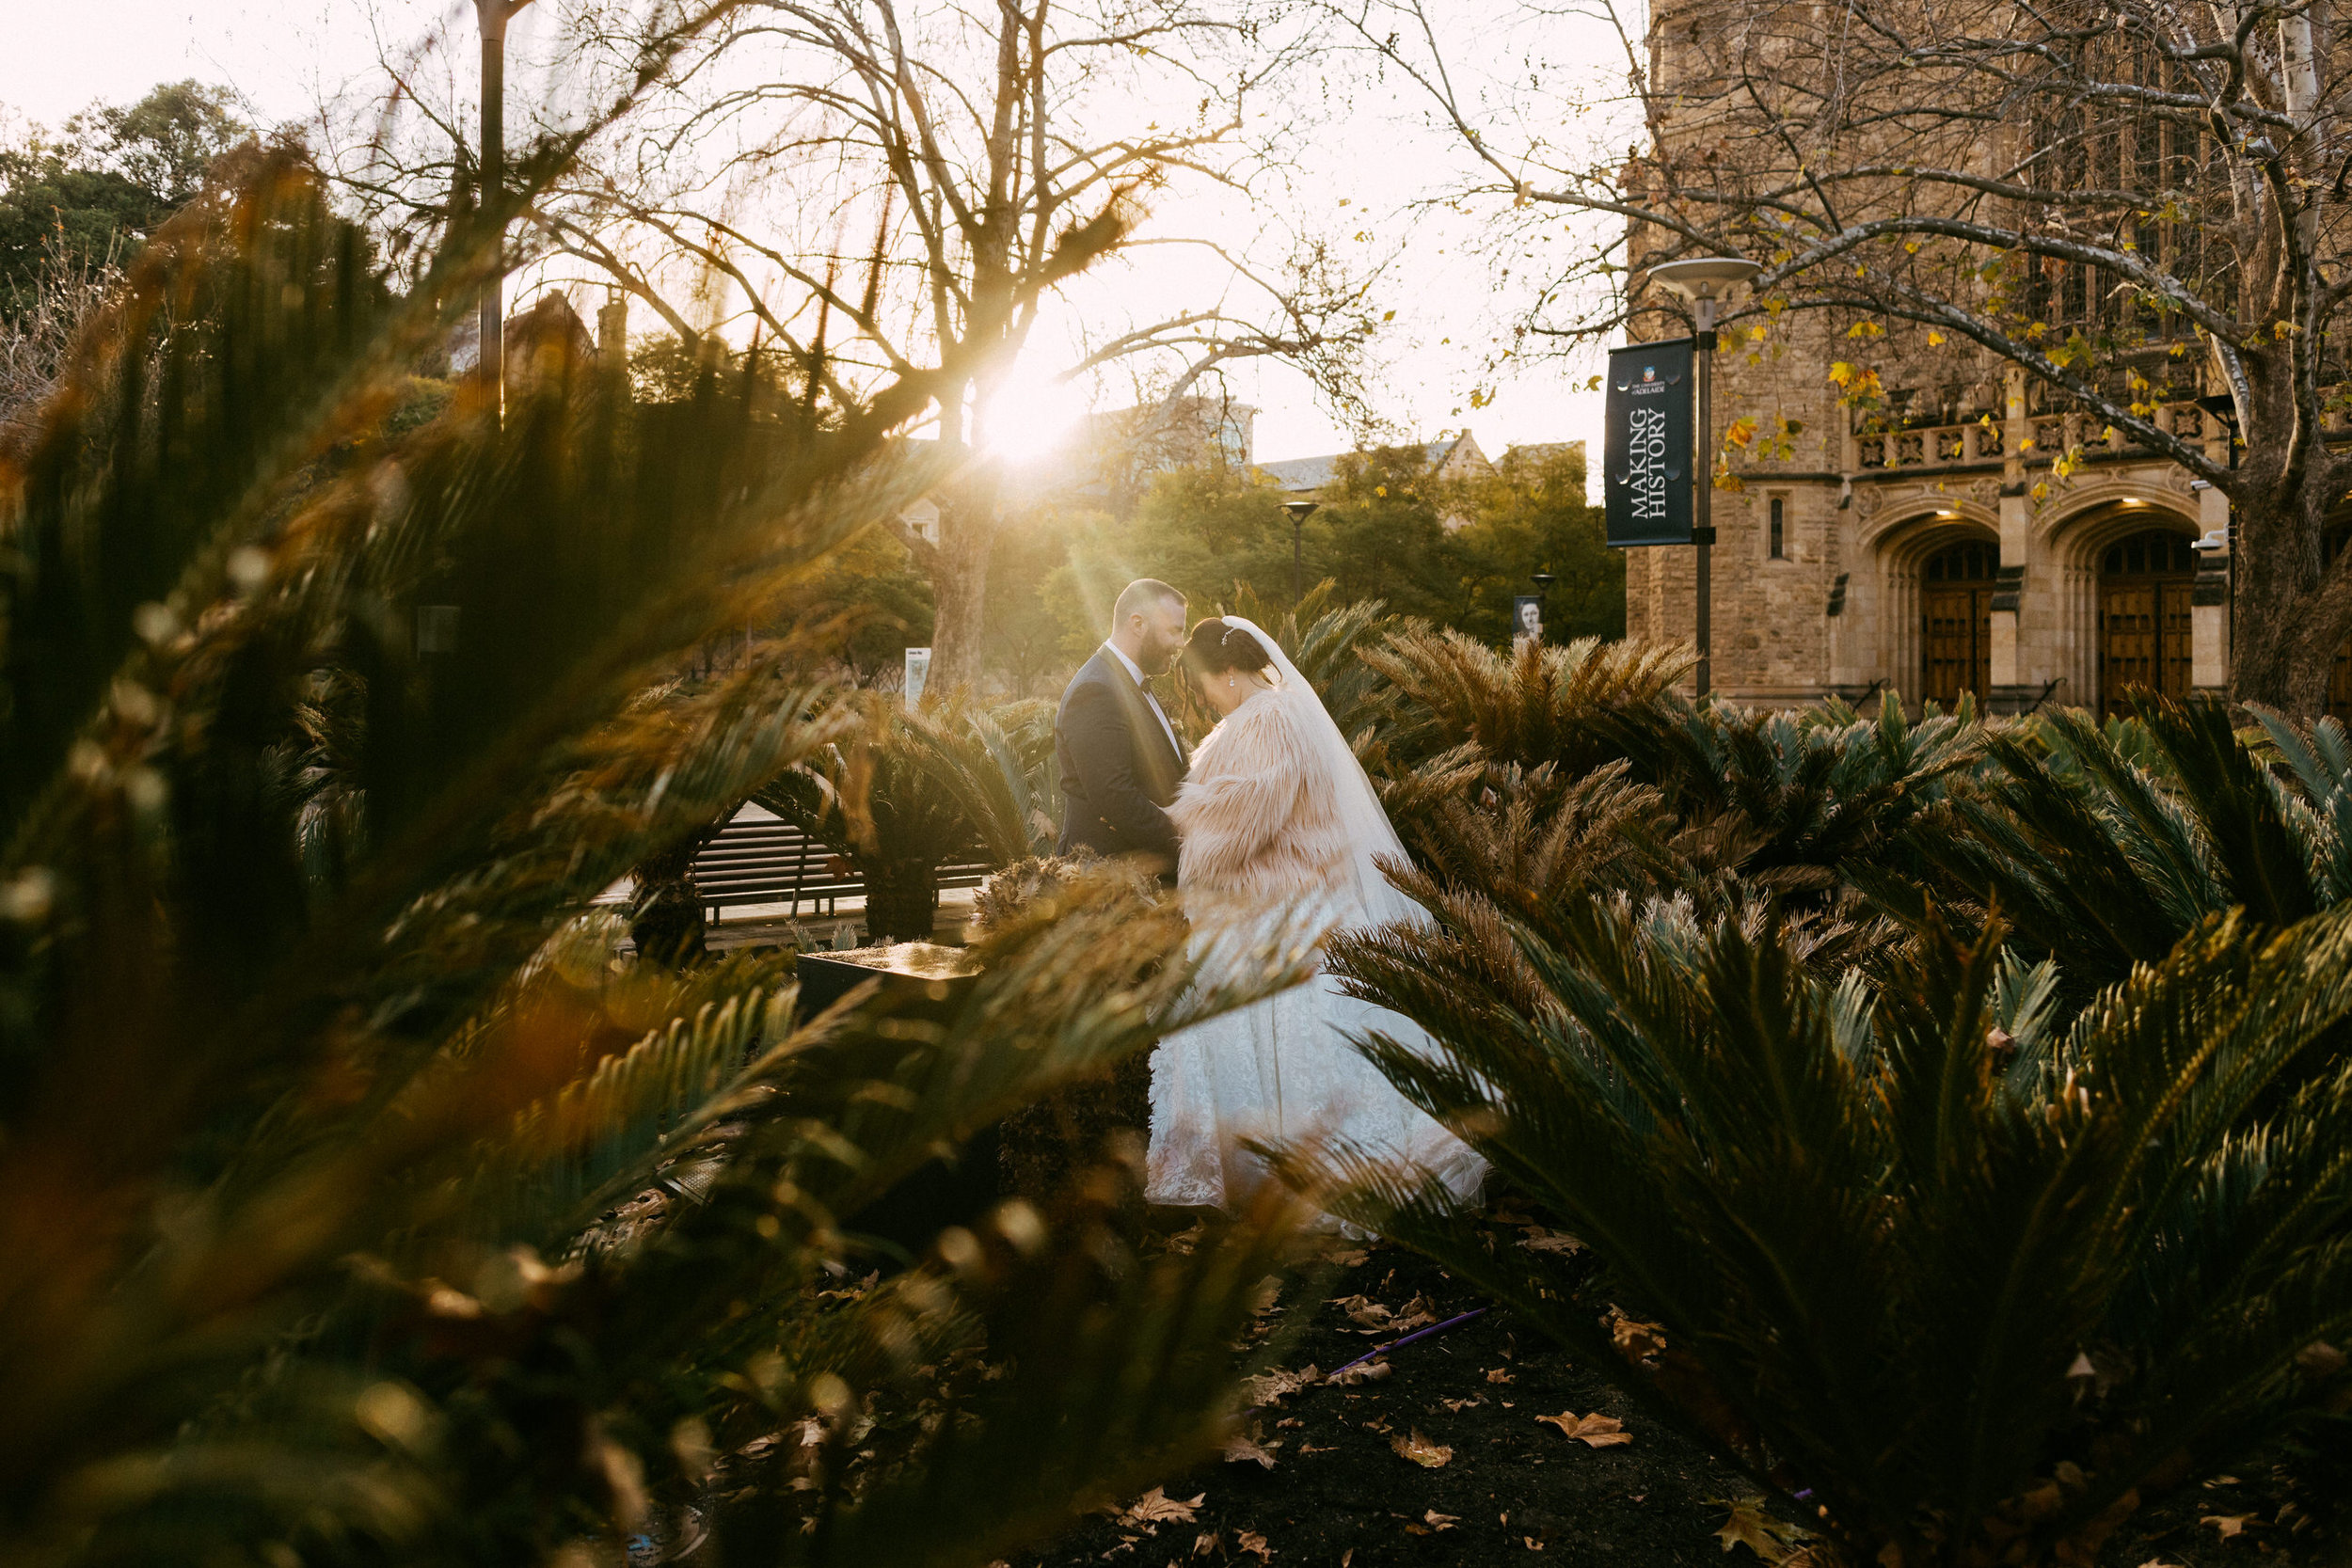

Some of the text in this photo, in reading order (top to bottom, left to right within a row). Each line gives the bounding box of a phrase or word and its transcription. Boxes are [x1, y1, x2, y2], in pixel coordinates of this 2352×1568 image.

[1636, 386, 1665, 395] ADELAIDE
[1629, 407, 1648, 519] MAKING
[1647, 407, 1666, 519] HISTORY
